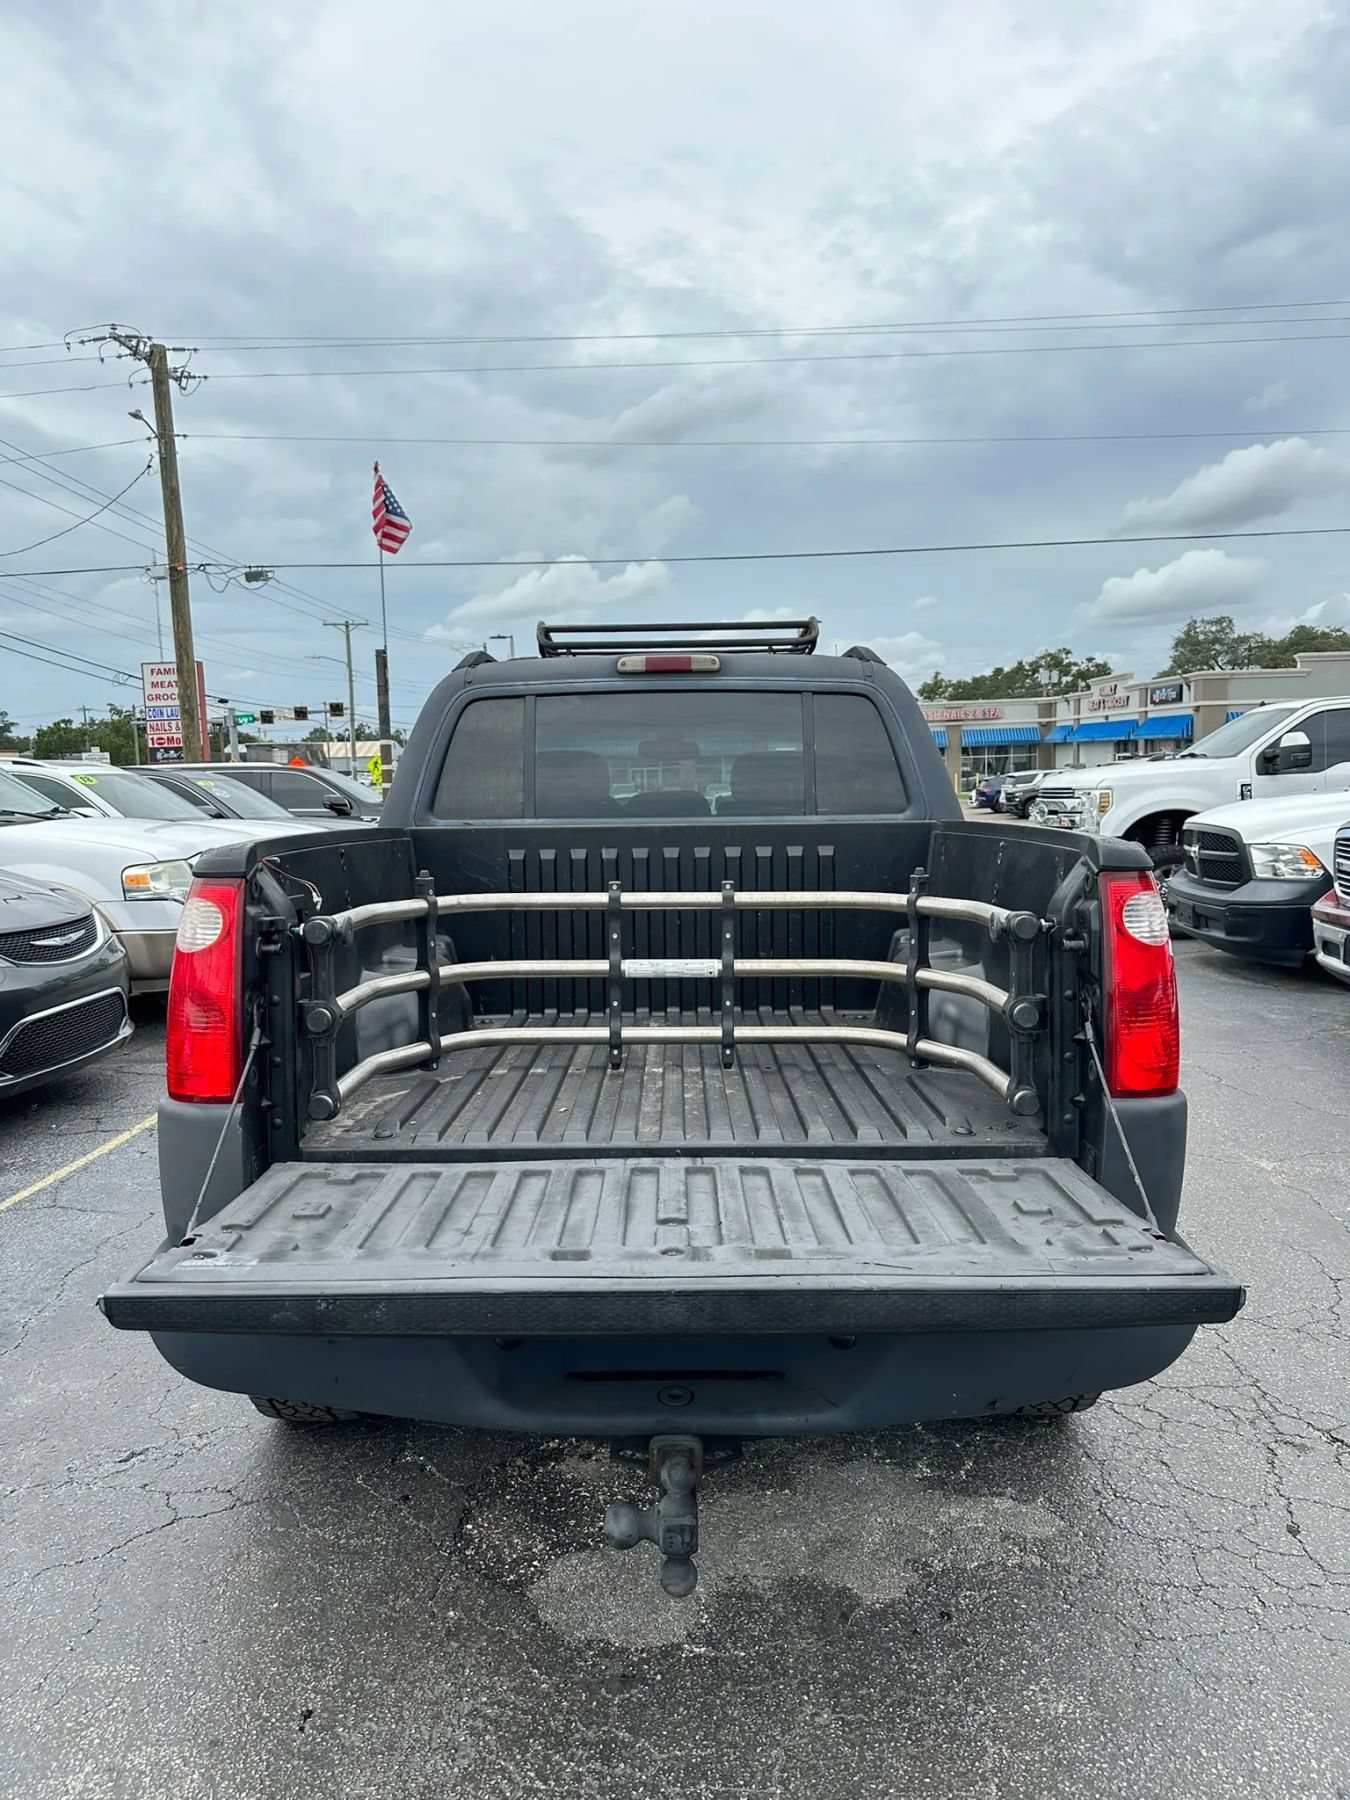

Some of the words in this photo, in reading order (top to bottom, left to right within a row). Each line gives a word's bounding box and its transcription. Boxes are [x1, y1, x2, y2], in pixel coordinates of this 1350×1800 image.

[150, 667, 176, 676] FAMI
[146, 693, 177, 702] GROC
[147, 708, 164, 719] COIN
[943, 709, 971, 719] NAILS
[984, 706, 1001, 718] SPA
[149, 721, 173, 732] NAILS
[175, 721, 181, 731] &
